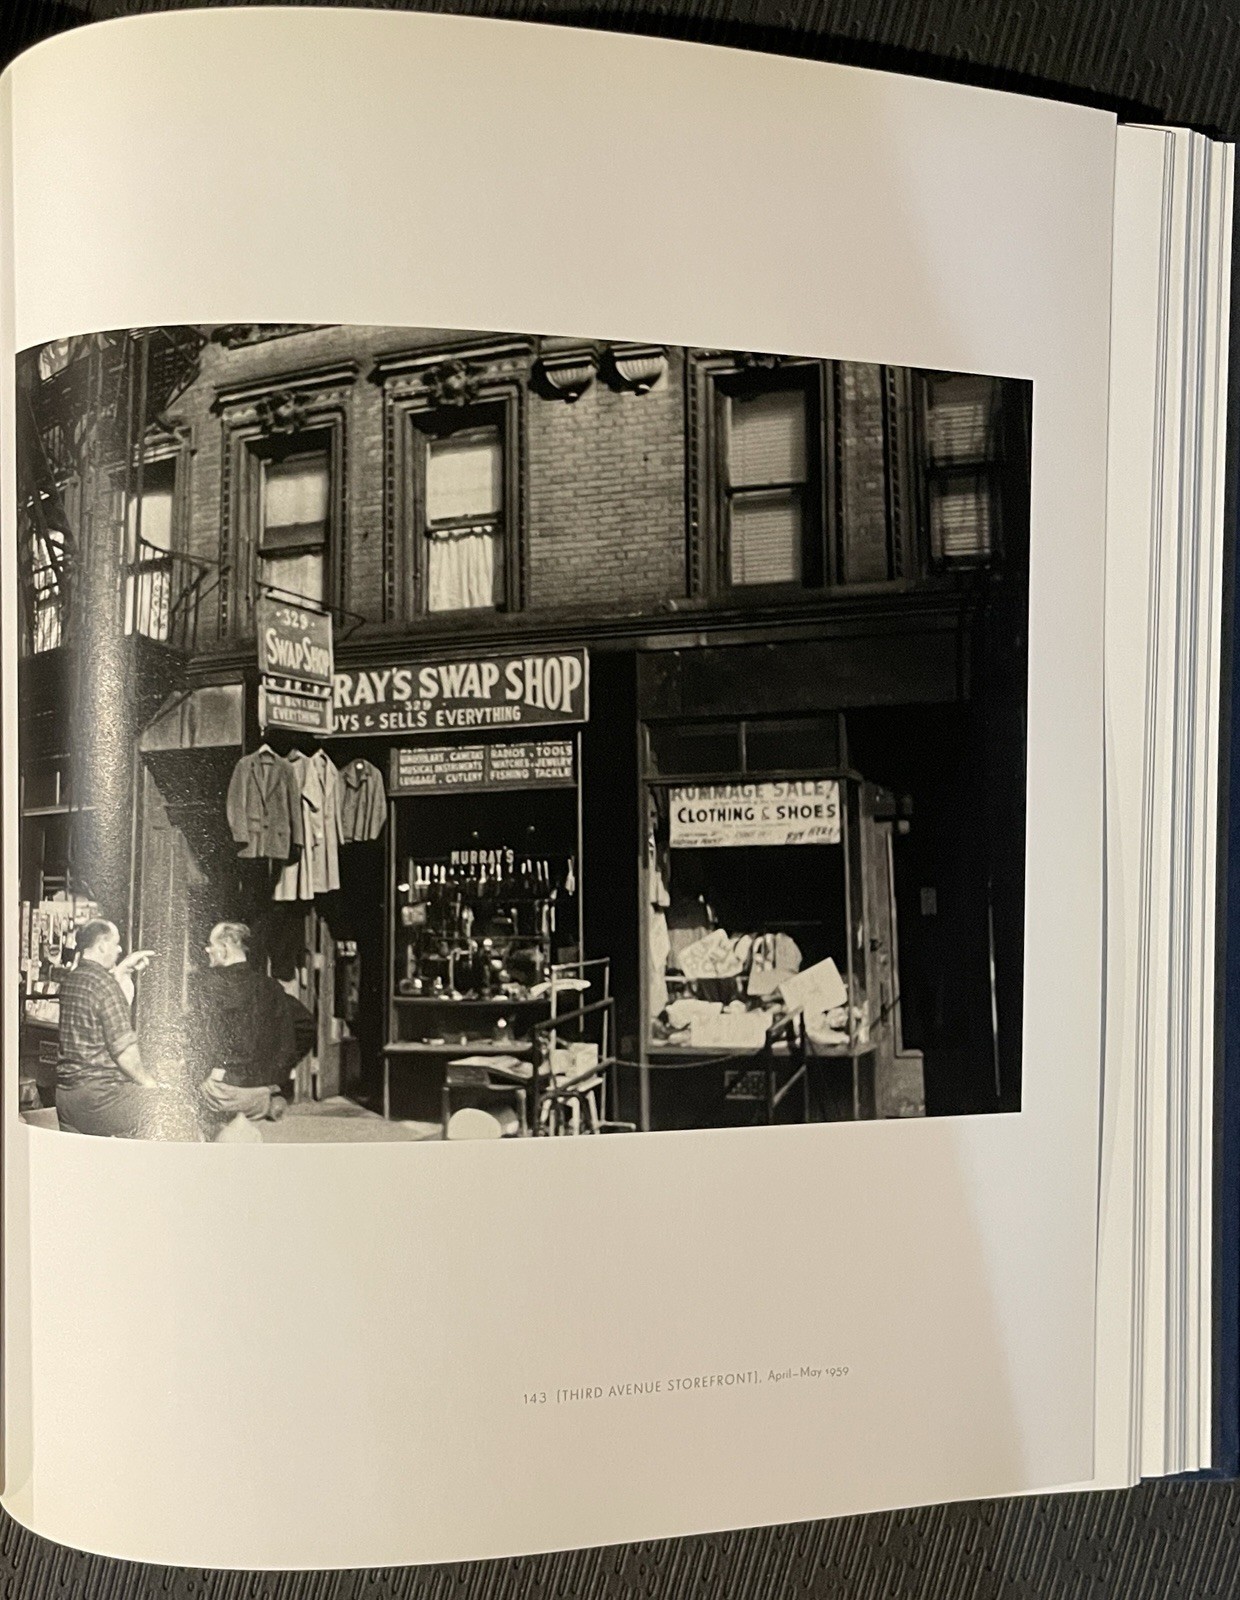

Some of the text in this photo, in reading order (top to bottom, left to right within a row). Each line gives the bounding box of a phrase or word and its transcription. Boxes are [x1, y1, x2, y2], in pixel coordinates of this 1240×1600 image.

[283, 609, 308, 630] 329
[333, 667, 412, 709] RAY'S
[419, 663, 499, 699] SWAP
[505, 655, 582, 713] SHOP
[404, 700, 432, 712] 329
[331, 713, 360, 733] UYS
[379, 711, 428, 730] SELLS
[435, 705, 521, 726] EVERYTHING
[536, 745, 572, 756] TOOLS
[535, 767, 571, 779] TACKLE
[678, 807, 754, 823] CLOTHING
[776, 804, 836, 820] SHOES
[523, 1391, 547, 1404] 143
[556, 1386, 603, 1403] [THIRD
[608, 1380, 662, 1397] AVENUE
[667, 1371, 763, 1391] STOREFRONT],
[825, 1366, 849, 1377] 1959
